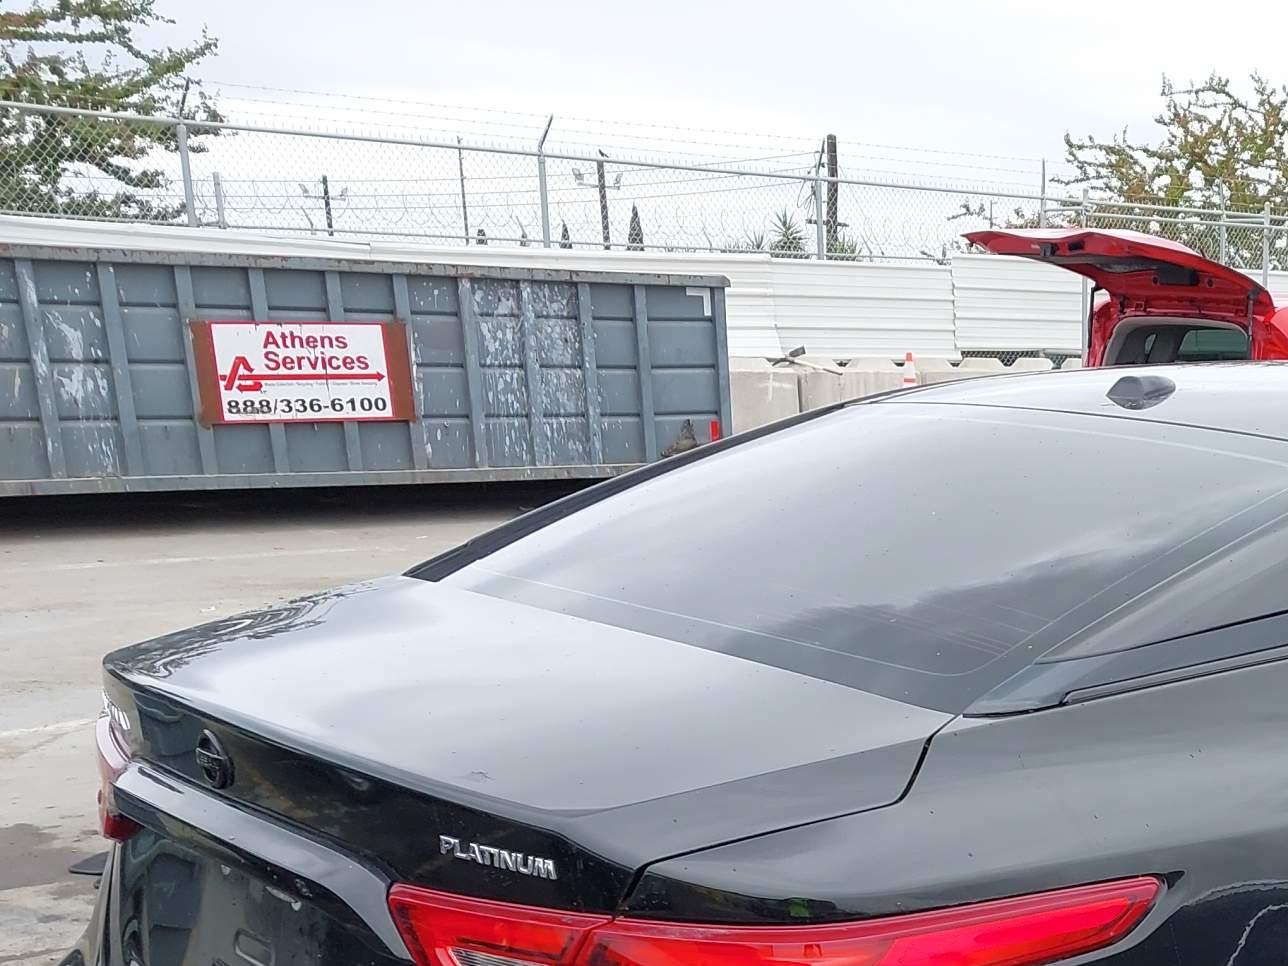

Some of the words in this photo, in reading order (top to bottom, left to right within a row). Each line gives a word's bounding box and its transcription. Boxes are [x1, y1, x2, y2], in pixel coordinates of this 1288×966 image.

[263, 331, 348, 350] Athens
[264, 351, 370, 371] Services
[227, 396, 387, 415] 888/336-6100
[439, 835, 558, 880] PLATINUM
